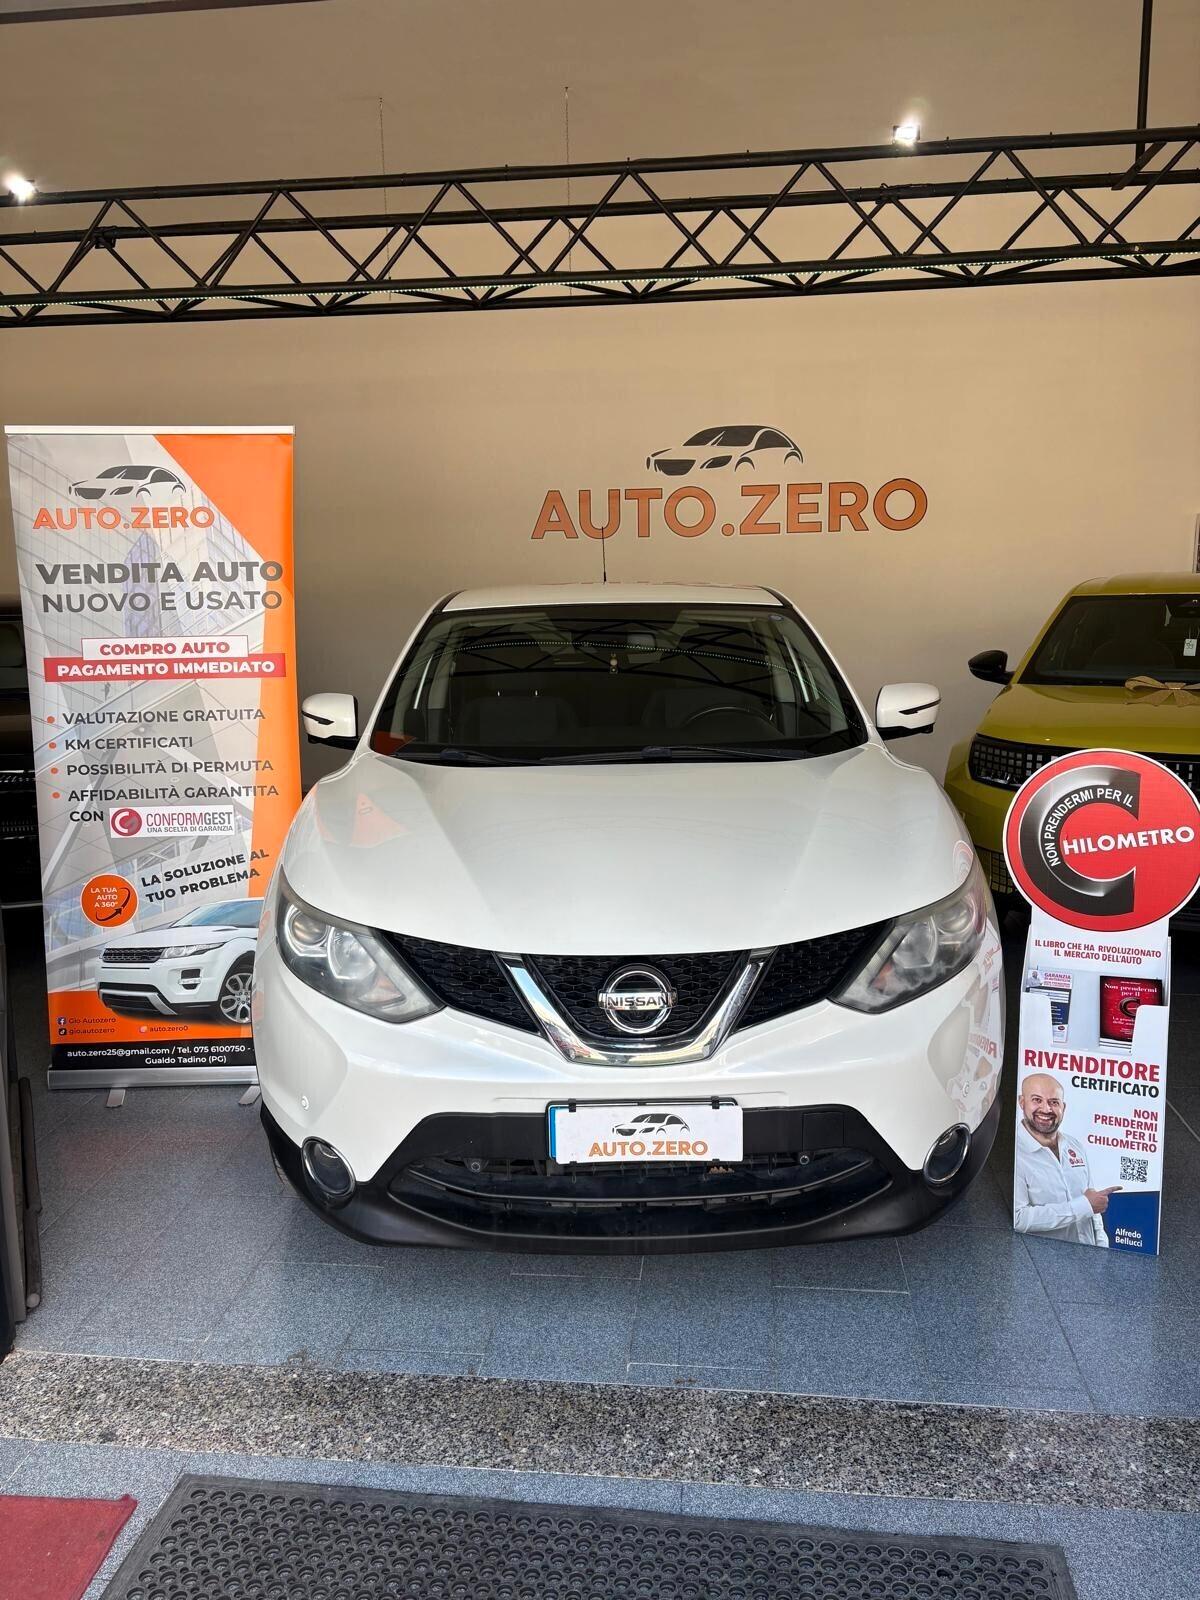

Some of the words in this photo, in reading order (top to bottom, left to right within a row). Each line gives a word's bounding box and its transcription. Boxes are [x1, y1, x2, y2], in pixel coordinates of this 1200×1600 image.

[530, 478, 928, 540] AUTO.ZERO
[33, 506, 215, 530] AUTO.ZERO
[35, 562, 185, 585] VENDITA
[192, 560, 283, 582] AUTO
[42, 592, 151, 613] NUOVO
[160, 592, 176, 611] E
[185, 590, 282, 611] USATO
[100, 643, 177, 656] COMPRO
[181, 641, 230, 655] AUTO
[57, 663, 169, 677] PAGAMENTO
[173, 661, 275, 674] IMMEDIATO
[63, 710, 179, 725] VALUTAZIONE
[183, 709, 265, 722] GRATUITA
[65, 738, 90, 751] KM
[95, 736, 193, 749] CERTIFICATI
[67, 760, 165, 776] POSSIBILITÀ
[171, 762, 188, 774] DI
[193, 760, 273, 773] PERMUTA
[68, 785, 180, 802] AFFIDABILITÀ
[183, 785, 279, 799] GARANTITA
[1097, 787, 1122, 802] PER
[1122, 793, 1134, 808] IL
[69, 810, 104, 823] CON
[146, 812, 233, 827] CONFORMGEST
[1044, 789, 1094, 840] PRENDERMI
[198, 825, 233, 833] GARANZIA
[1063, 826, 1195, 855] HILOMETRO
[1046, 841, 1061, 867] NON
[141, 874, 161, 887] LA
[164, 854, 246, 882] SOLUZIONE
[250, 849, 269, 861] AL
[146, 889, 176, 903] TUO
[181, 868, 260, 896] PROBLEMA
[1035, 939, 1042, 947] IL
[1043, 940, 1066, 949] LIBRO
[1067, 942, 1082, 951] CHE
[1083, 943, 1095, 952] HA
[1098, 945, 1162, 959] RIVOLUZIONATO
[1054, 949, 1061, 957] IL
[1063, 950, 1100, 961] MERCATO
[1101, 953, 1142, 965] DELL'AUTO
[607, 996, 668, 1007] NISSAN
[69, 1028, 115, 1036] gio.autozero
[67, 1047, 170, 1058] auto.zero25@gmail.com
[172, 1046, 176, 1055] /
[177, 1046, 192, 1054] Tel.
[194, 1046, 209, 1054] 075
[210, 1045, 246, 1053] 6100750
[145, 1056, 176, 1065] Gualdo
[177, 1055, 207, 1064] Tadino
[208, 1055, 227, 1064] (PG)
[1024, 1049, 1160, 1082] RIVENDITORE
[1071, 1075, 1159, 1098] CERTIFICATO
[1094, 1114, 1158, 1132] PRENDERMI
[1133, 1109, 1158, 1122] NON
[1087, 1134, 1157, 1153] CHILOMETRO
[1125, 1129, 1144, 1141] PER
[1148, 1131, 1158, 1143] IL
[588, 1141, 708, 1158] AUTO.ZERO
[1115, 1228, 1141, 1239] Alfredo
[1115, 1236, 1143, 1247] Bellucci
